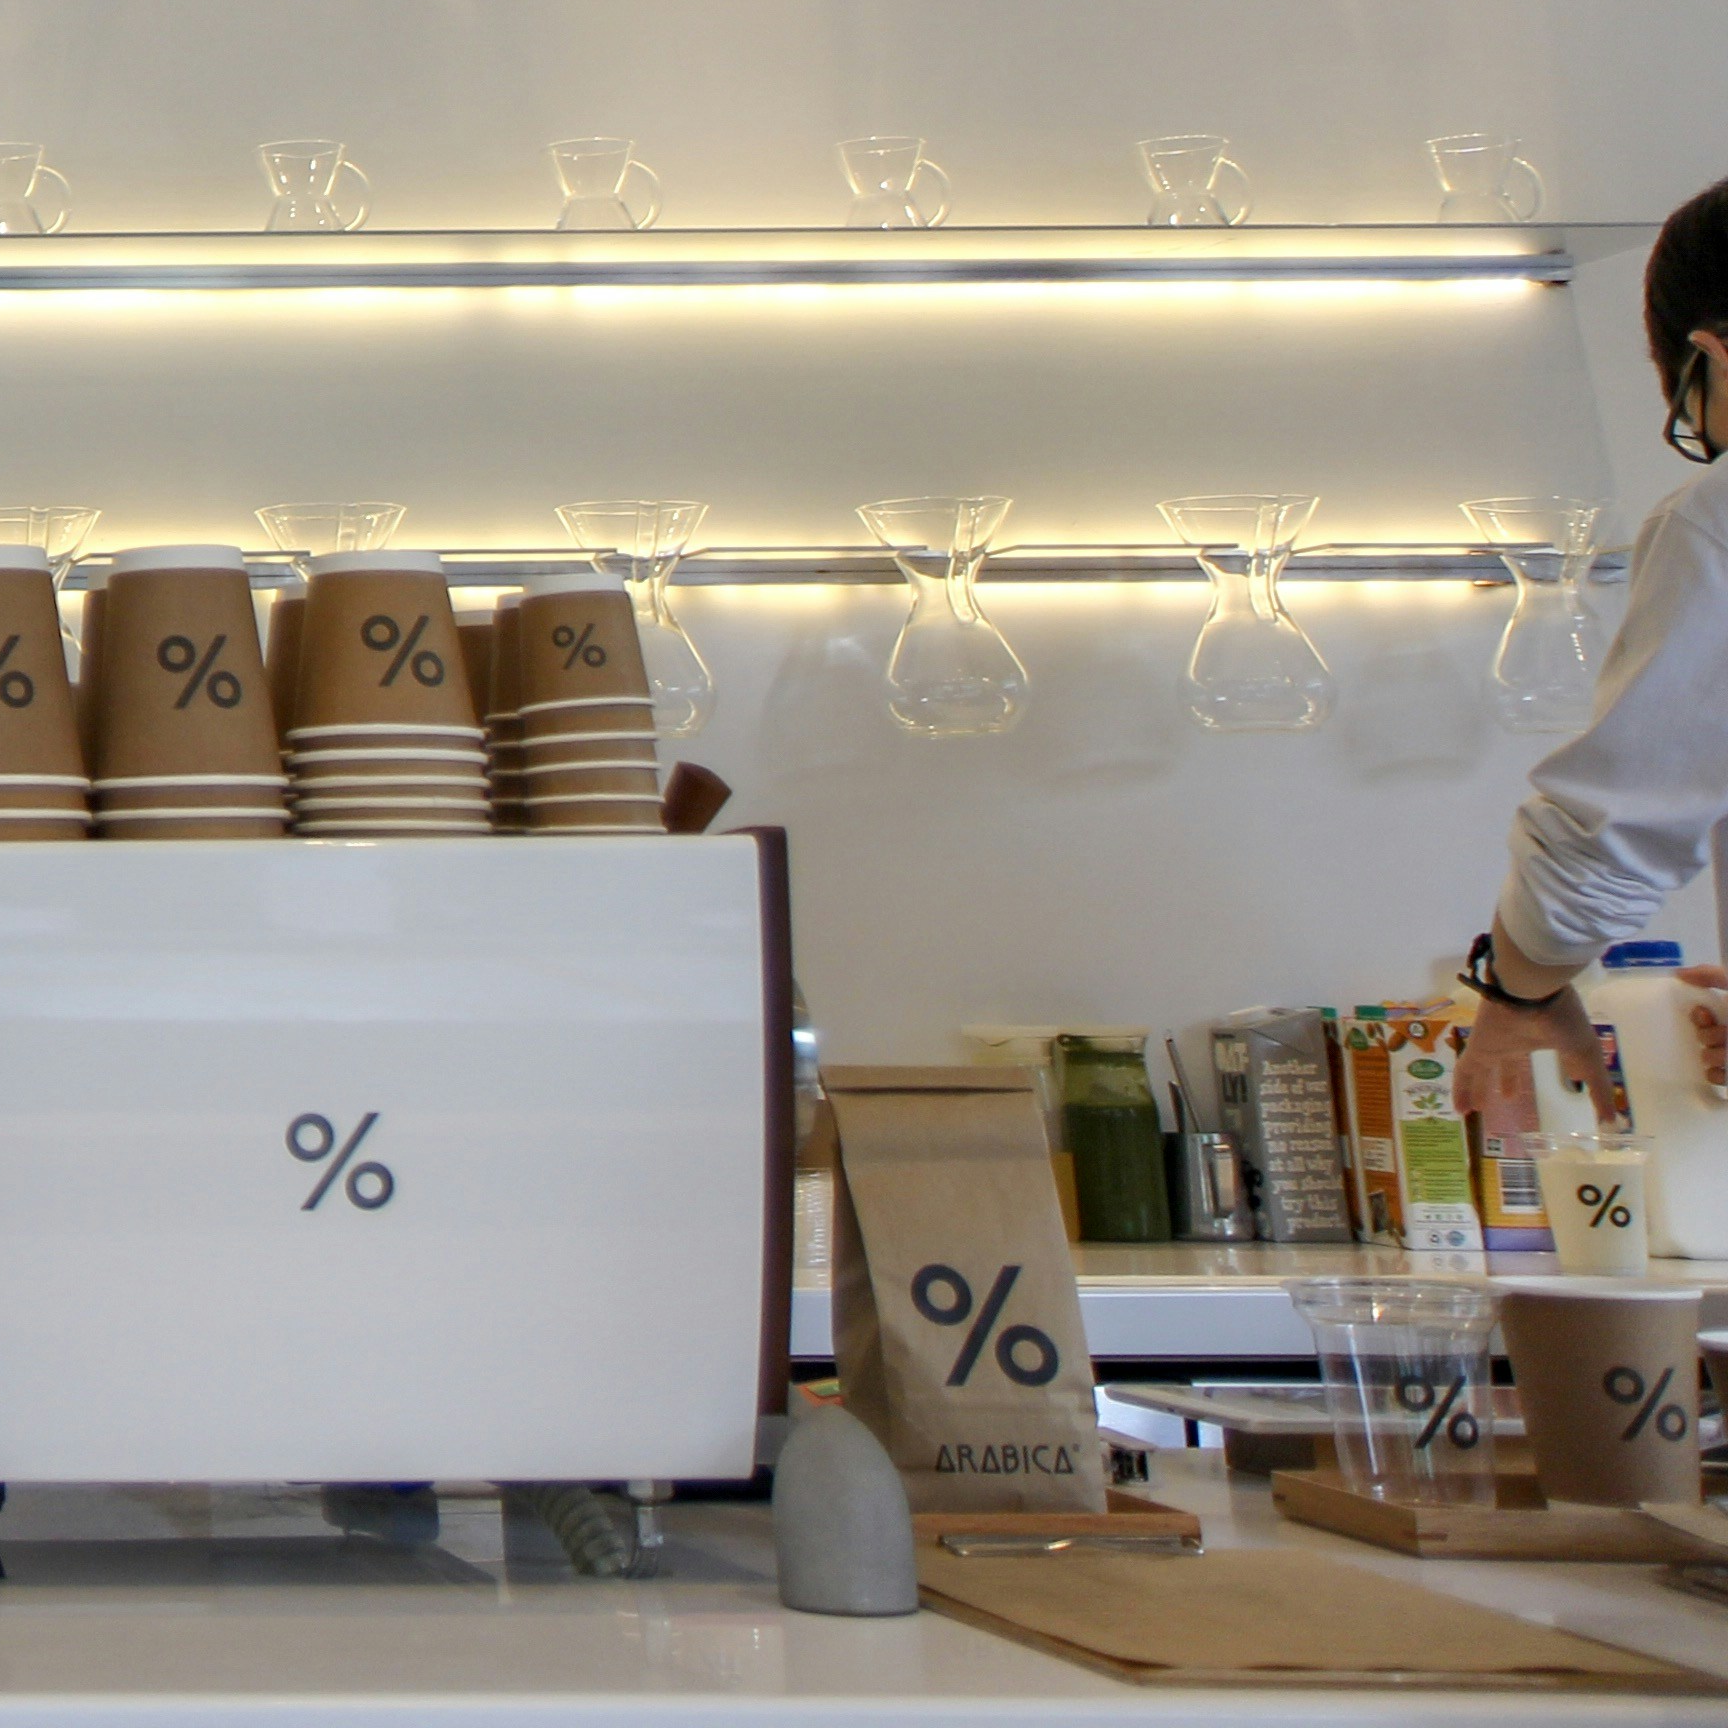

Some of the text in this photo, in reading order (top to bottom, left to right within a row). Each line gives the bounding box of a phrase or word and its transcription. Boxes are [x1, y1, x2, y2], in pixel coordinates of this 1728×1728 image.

[156, 633, 242, 710] %
[361, 614, 446, 688] %
[551, 622, 608, 670] %
[285, 1112, 395, 1211] %
[1576, 1183, 1632, 1229] %
[910, 1264, 1060, 1388] %
[1394, 1374, 1480, 1450] %
[1602, 1366, 1688, 1442] %
[934, 1443, 1075, 1475] ARABICA
